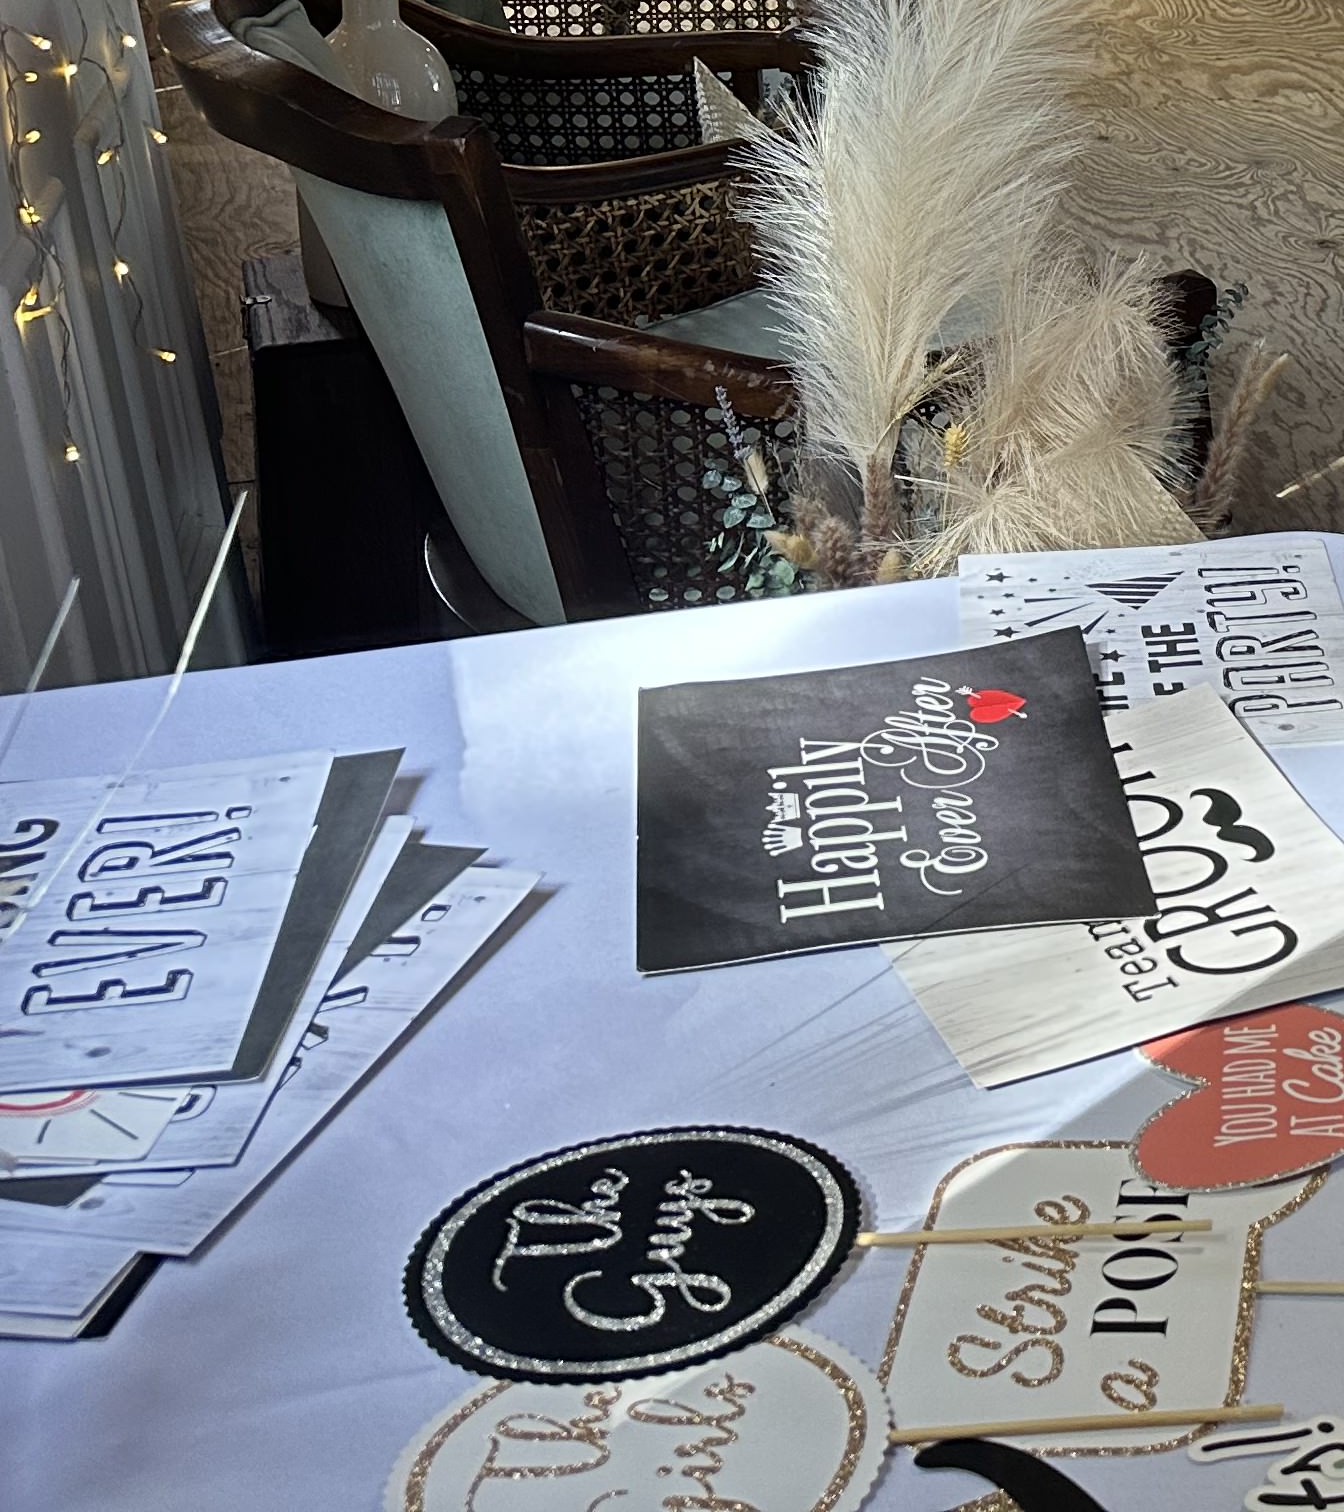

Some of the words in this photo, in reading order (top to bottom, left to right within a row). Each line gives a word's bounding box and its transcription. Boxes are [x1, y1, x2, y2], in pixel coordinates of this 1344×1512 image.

[1141, 622, 1204, 674] THE
[1197, 564, 1344, 719] PARTY!
[859, 676, 999, 789] After
[767, 737, 908, 924] Happily
[900, 789, 989, 896] Ever
[1108, 742, 1299, 976] GRO
[20, 805, 253, 1016] EVER!
[1221, 1058, 1277, 1099] HAD
[1222, 1023, 1280, 1055] ME
[1213, 1103, 1278, 1147] YOU
[492, 1167, 630, 1292] The
[563, 1168, 756, 1332] Guys
[945, 1194, 1092, 1389] Strike
[463, 1383, 624, 1512] The
[586, 1372, 758, 1512] irls
[1100, 1357, 1160, 1412] a
